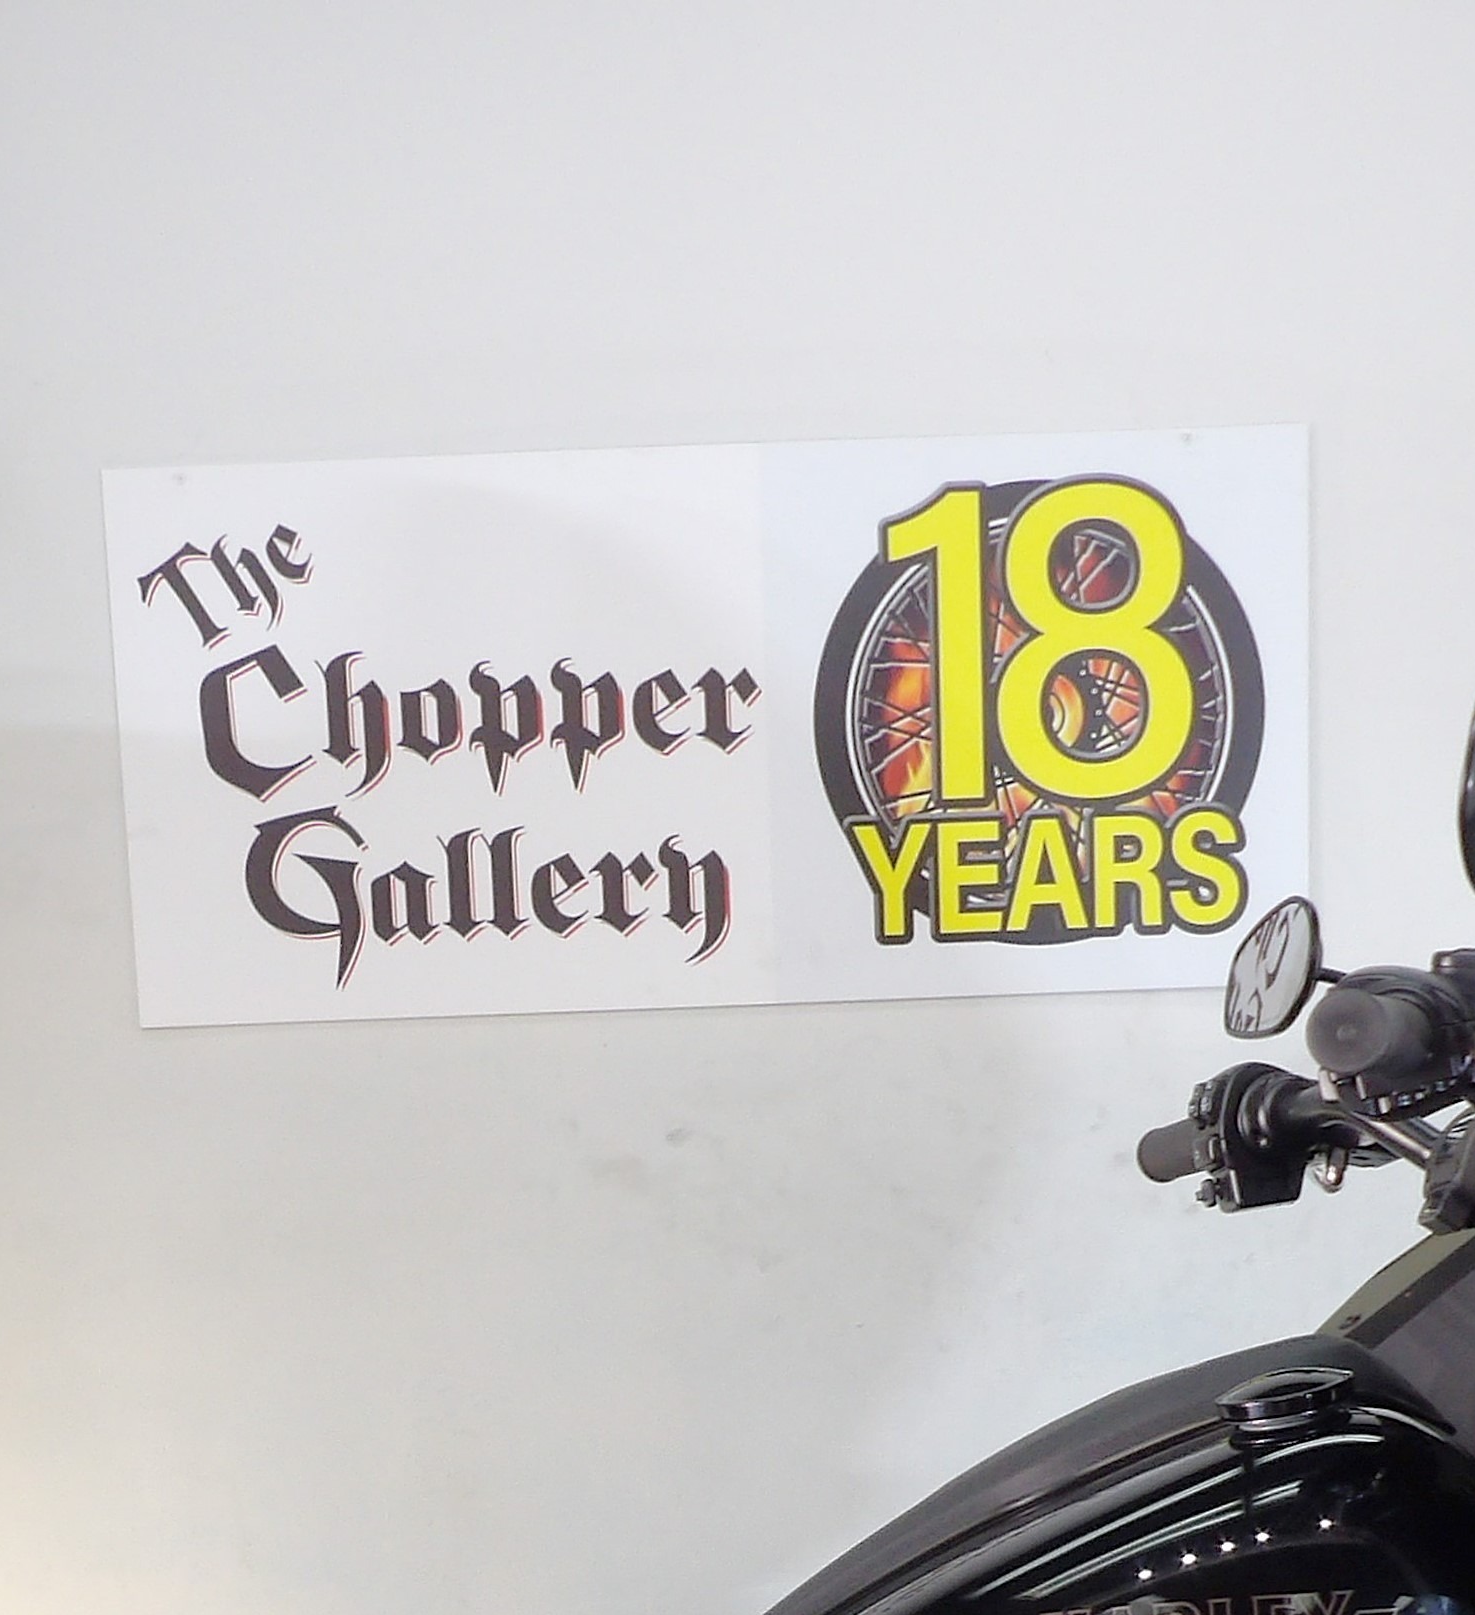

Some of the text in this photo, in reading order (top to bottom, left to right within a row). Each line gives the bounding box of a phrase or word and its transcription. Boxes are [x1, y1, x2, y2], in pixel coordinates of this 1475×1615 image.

[136, 523, 315, 650] The
[881, 476, 1197, 806] 18
[199, 644, 763, 803] Chopper
[244, 804, 733, 992] Gallery
[849, 807, 1244, 941] YEARS
